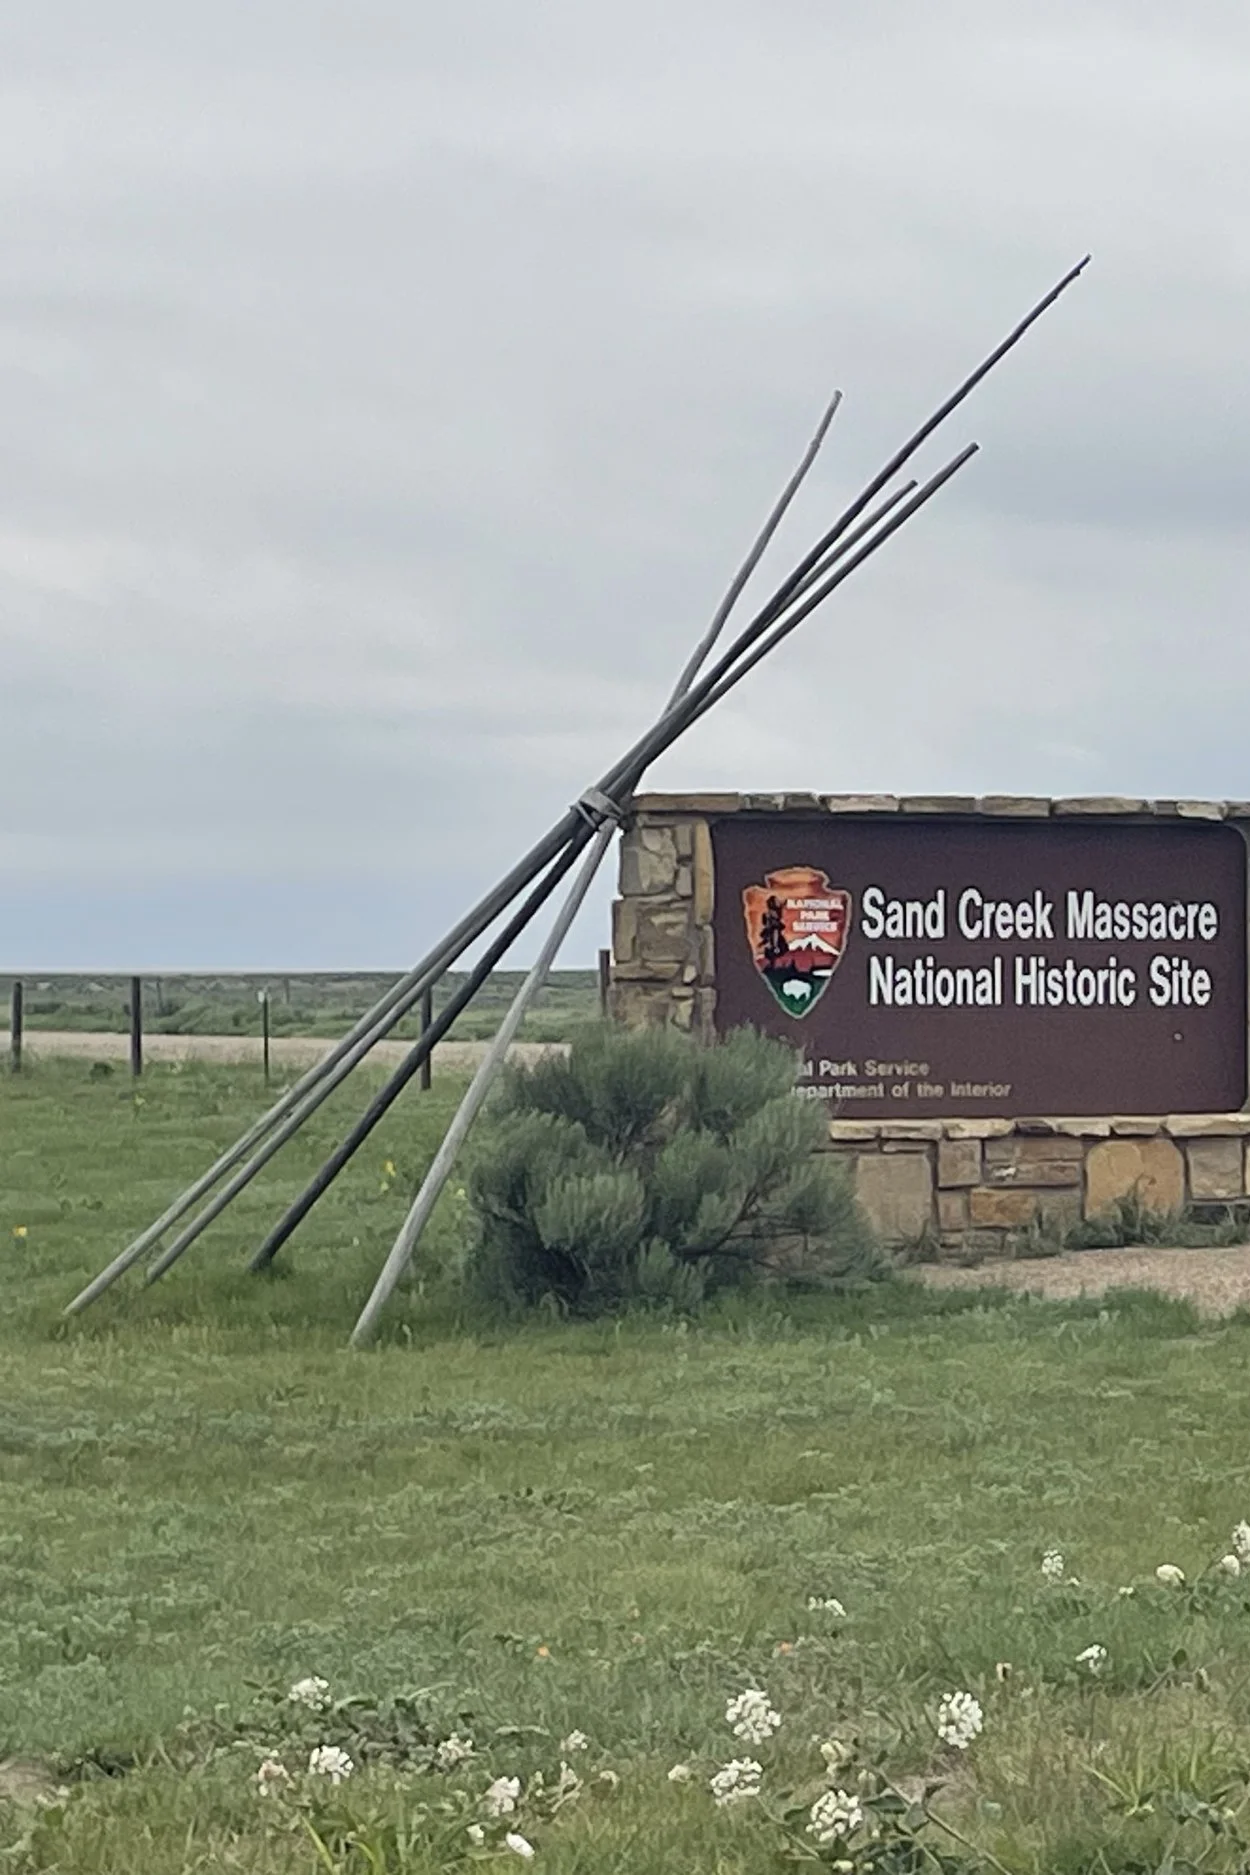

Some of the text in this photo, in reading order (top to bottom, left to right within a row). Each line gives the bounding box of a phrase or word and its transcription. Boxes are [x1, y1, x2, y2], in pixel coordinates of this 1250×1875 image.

[862, 887, 1218, 940] Sand Creek Massacre
[869, 955, 1212, 1006] National Historic Site
[819, 1060, 858, 1076] Park
[864, 1059, 930, 1076] Service
[791, 1081, 1012, 1099] epartment of the Interior
